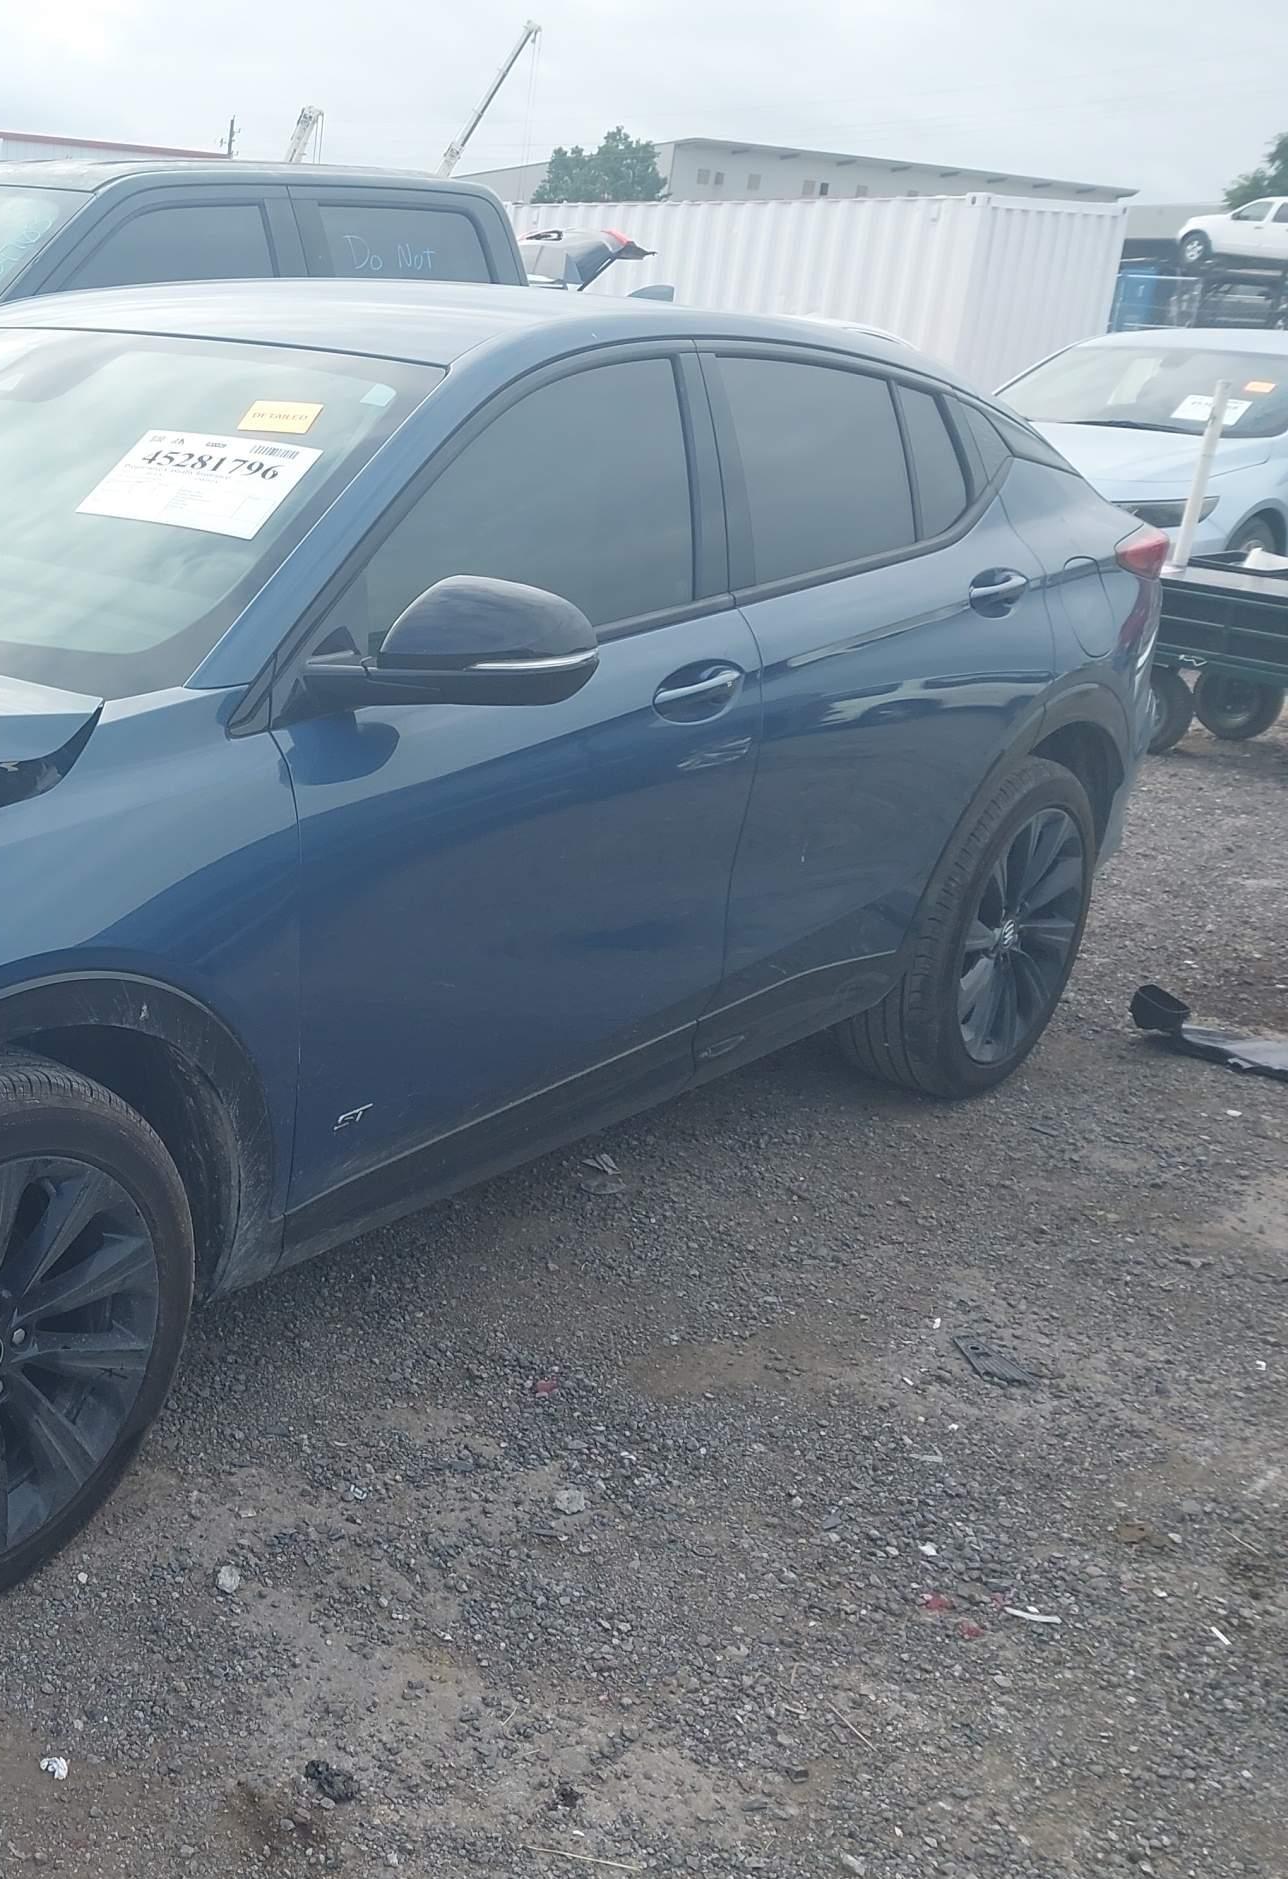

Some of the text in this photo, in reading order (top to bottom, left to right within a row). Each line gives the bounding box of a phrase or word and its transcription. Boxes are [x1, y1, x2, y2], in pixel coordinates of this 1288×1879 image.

[343, 234, 383, 271] Do
[141, 449, 287, 481] 45281796
[333, 1103, 374, 1131] ST
